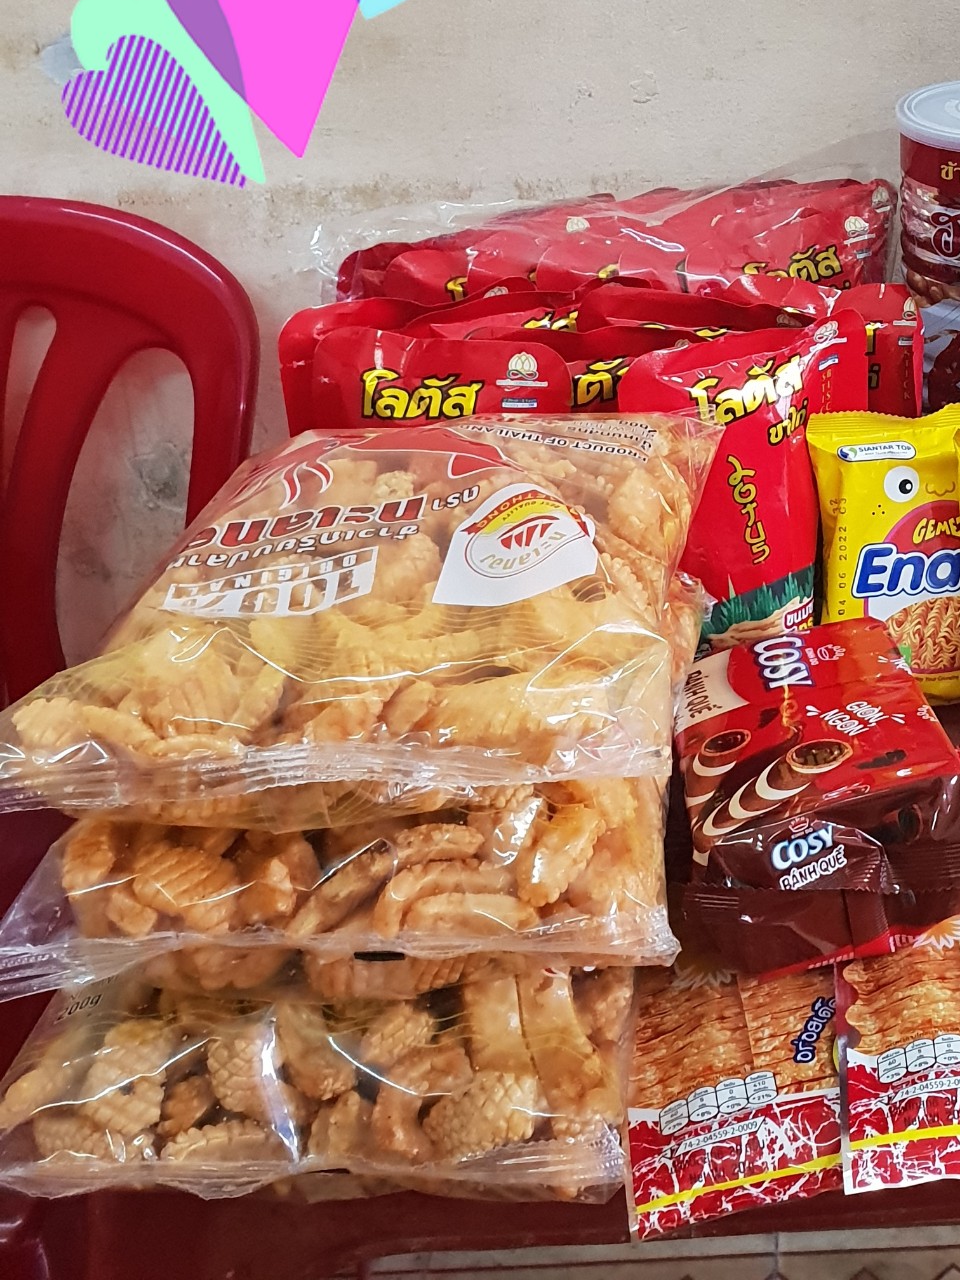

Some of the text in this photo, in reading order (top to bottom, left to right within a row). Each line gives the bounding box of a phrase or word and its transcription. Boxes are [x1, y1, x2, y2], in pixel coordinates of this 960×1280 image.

[362, 368, 484, 418] โลตัส
[689, 354, 804, 424] โลตัส
[460, 424, 648, 462] PRODUCT OF THAILAND
[858, 444, 894, 453] SIANTAR
[896, 443, 912, 451] TOP
[431, 484, 480, 513] ตรา
[502, 500, 537, 521] QUALITY
[480, 530, 567, 571] ทะเลทอง
[838, 526, 847, 561] 2022
[838, 573, 847, 589] 06
[754, 636, 813, 689] COSY
[821, 708, 869, 736] NGON
[771, 824, 834, 871] COSY
